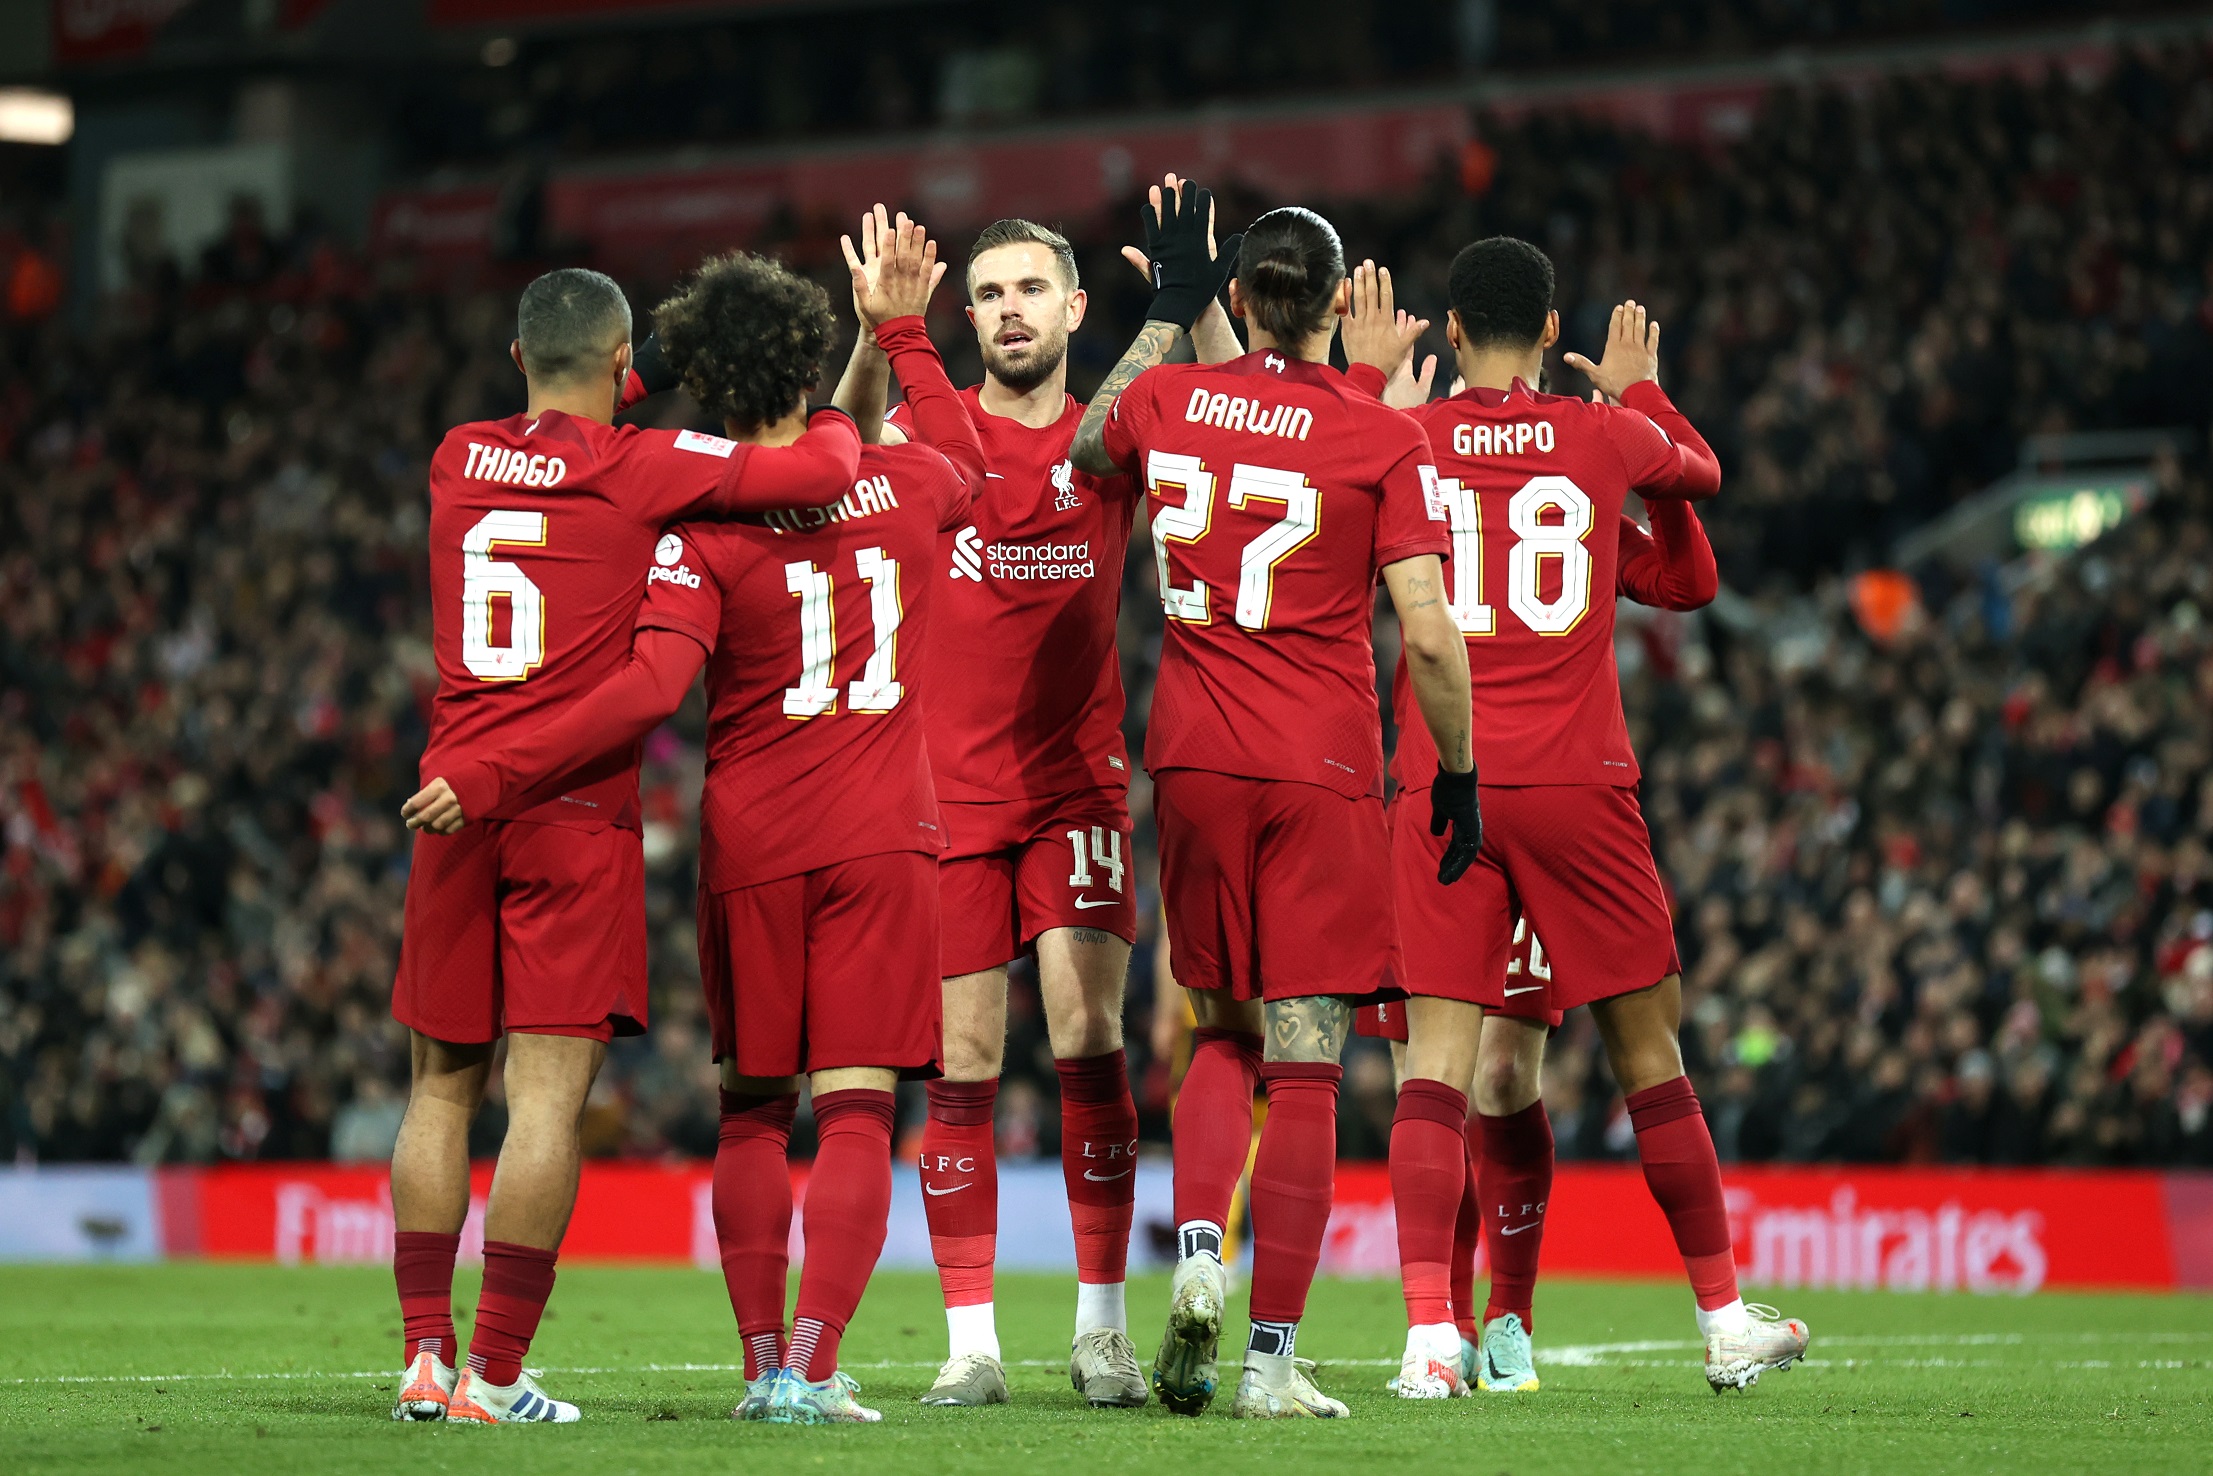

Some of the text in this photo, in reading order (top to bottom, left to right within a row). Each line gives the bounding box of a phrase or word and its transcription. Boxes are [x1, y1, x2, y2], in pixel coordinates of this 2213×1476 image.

[1185, 387, 1313, 442] DARWIN
[1453, 421, 1555, 456] GAKPO
[463, 442, 567, 489] THIAGO
[986, 540, 1088, 561] standard
[1147, 449, 1323, 633] 27
[1438, 475, 1595, 637] 18
[462, 509, 548, 682] 6
[647, 564, 701, 589] pedia
[990, 559, 1095, 581] chartered
[783, 547, 904, 721] 11
[1067, 826, 1124, 894] 14
